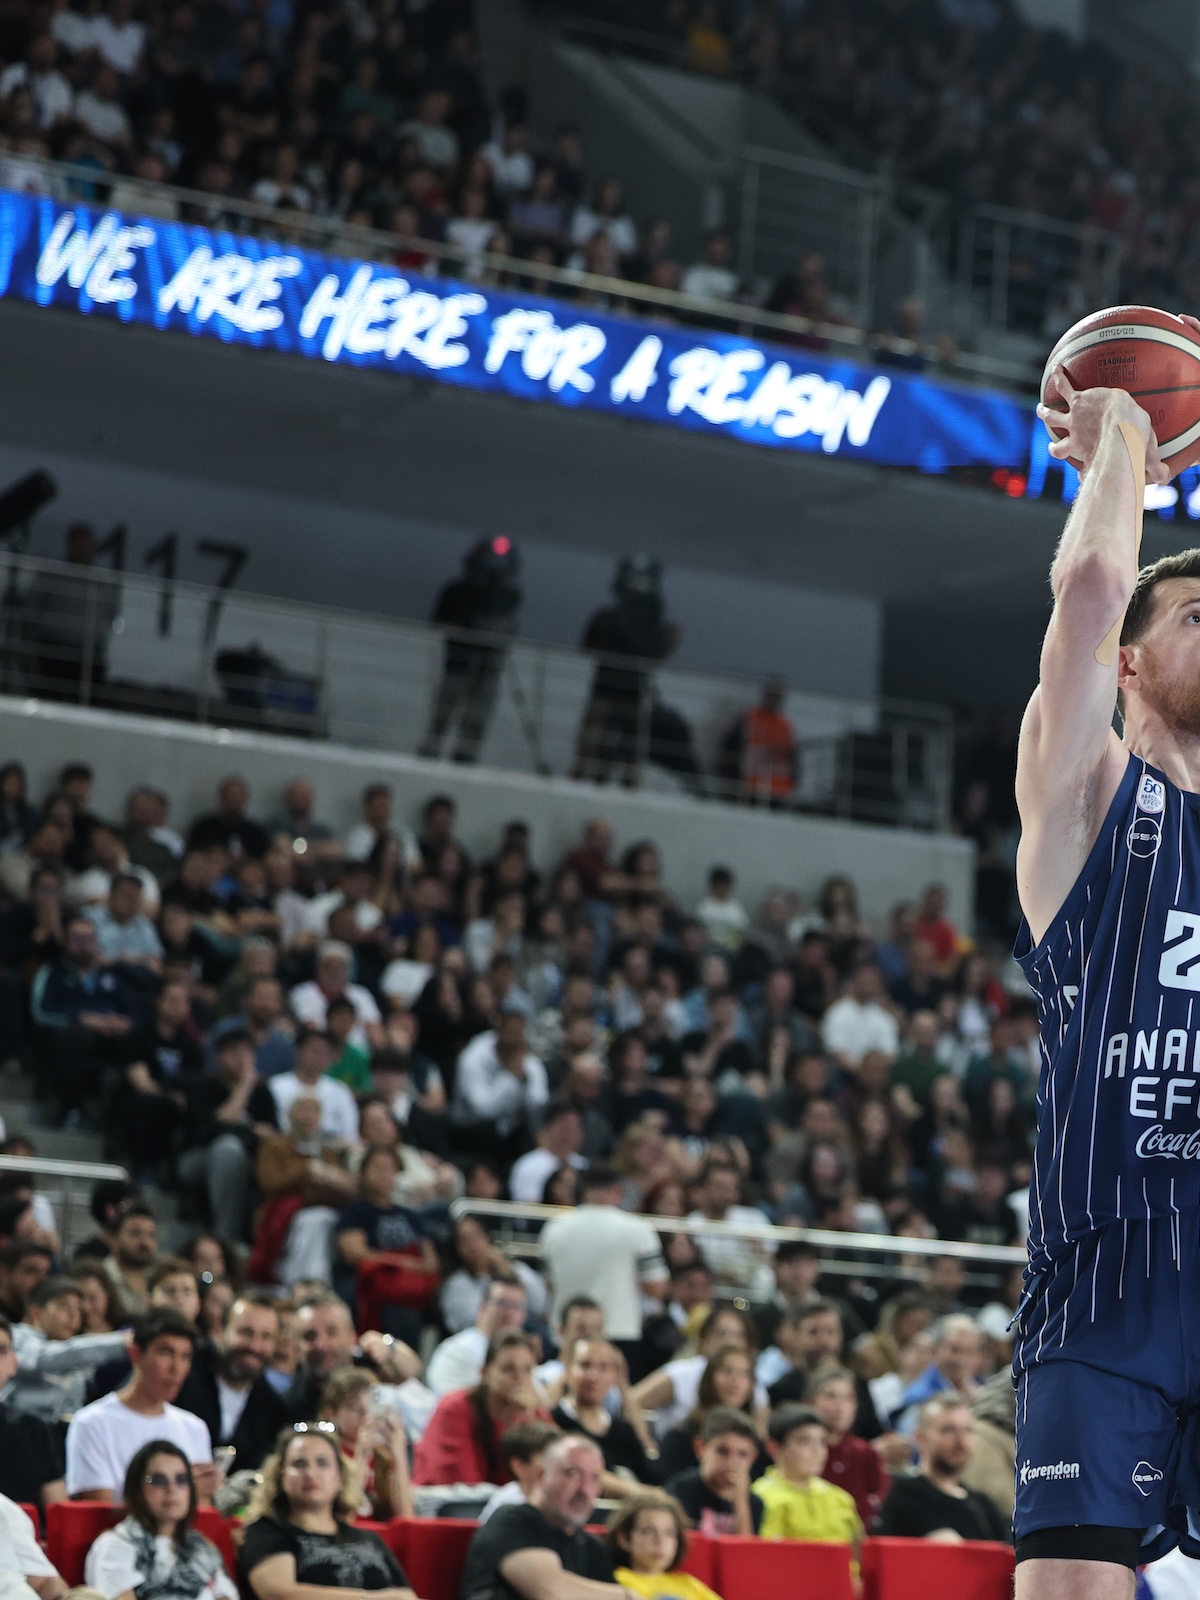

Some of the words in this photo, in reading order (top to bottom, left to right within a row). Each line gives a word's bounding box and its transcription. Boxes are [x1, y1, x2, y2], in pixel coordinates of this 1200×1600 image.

[36, 210, 156, 304] WE
[159, 245, 300, 333] ARE
[300, 262, 487, 370] HERE
[484, 306, 607, 393] FOR
[610, 334, 663, 402] A
[667, 345, 892, 454] REASON
[1097, 364, 1138, 385] FIBA
[1143, 778, 1163, 796] 50
[1027, 1460, 1080, 1481] corendon
[1046, 1472, 1080, 1481] AIRLINES
